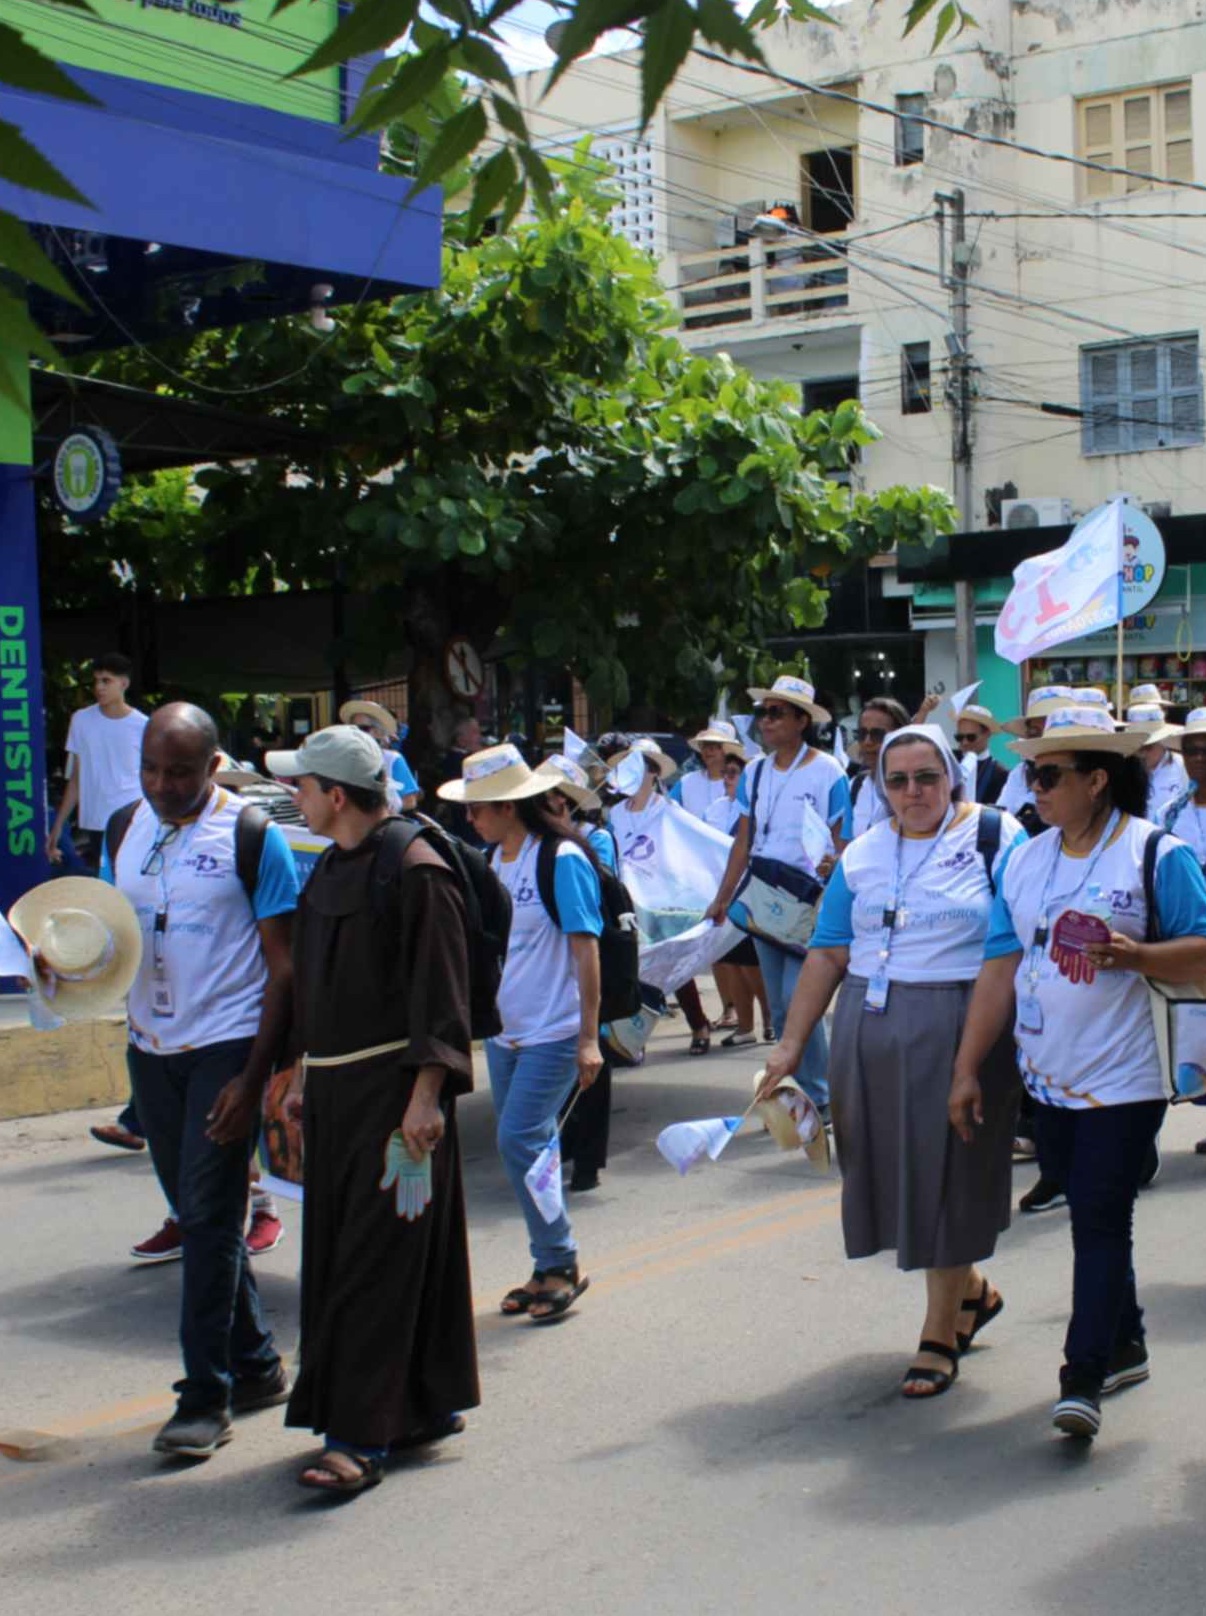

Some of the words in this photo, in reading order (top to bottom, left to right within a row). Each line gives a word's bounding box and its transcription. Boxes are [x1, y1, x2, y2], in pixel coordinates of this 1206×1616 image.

[190, 0, 243, 27] todos
[1122, 563, 1155, 583] HOP
[0, 605, 36, 856] DENTISTAS
